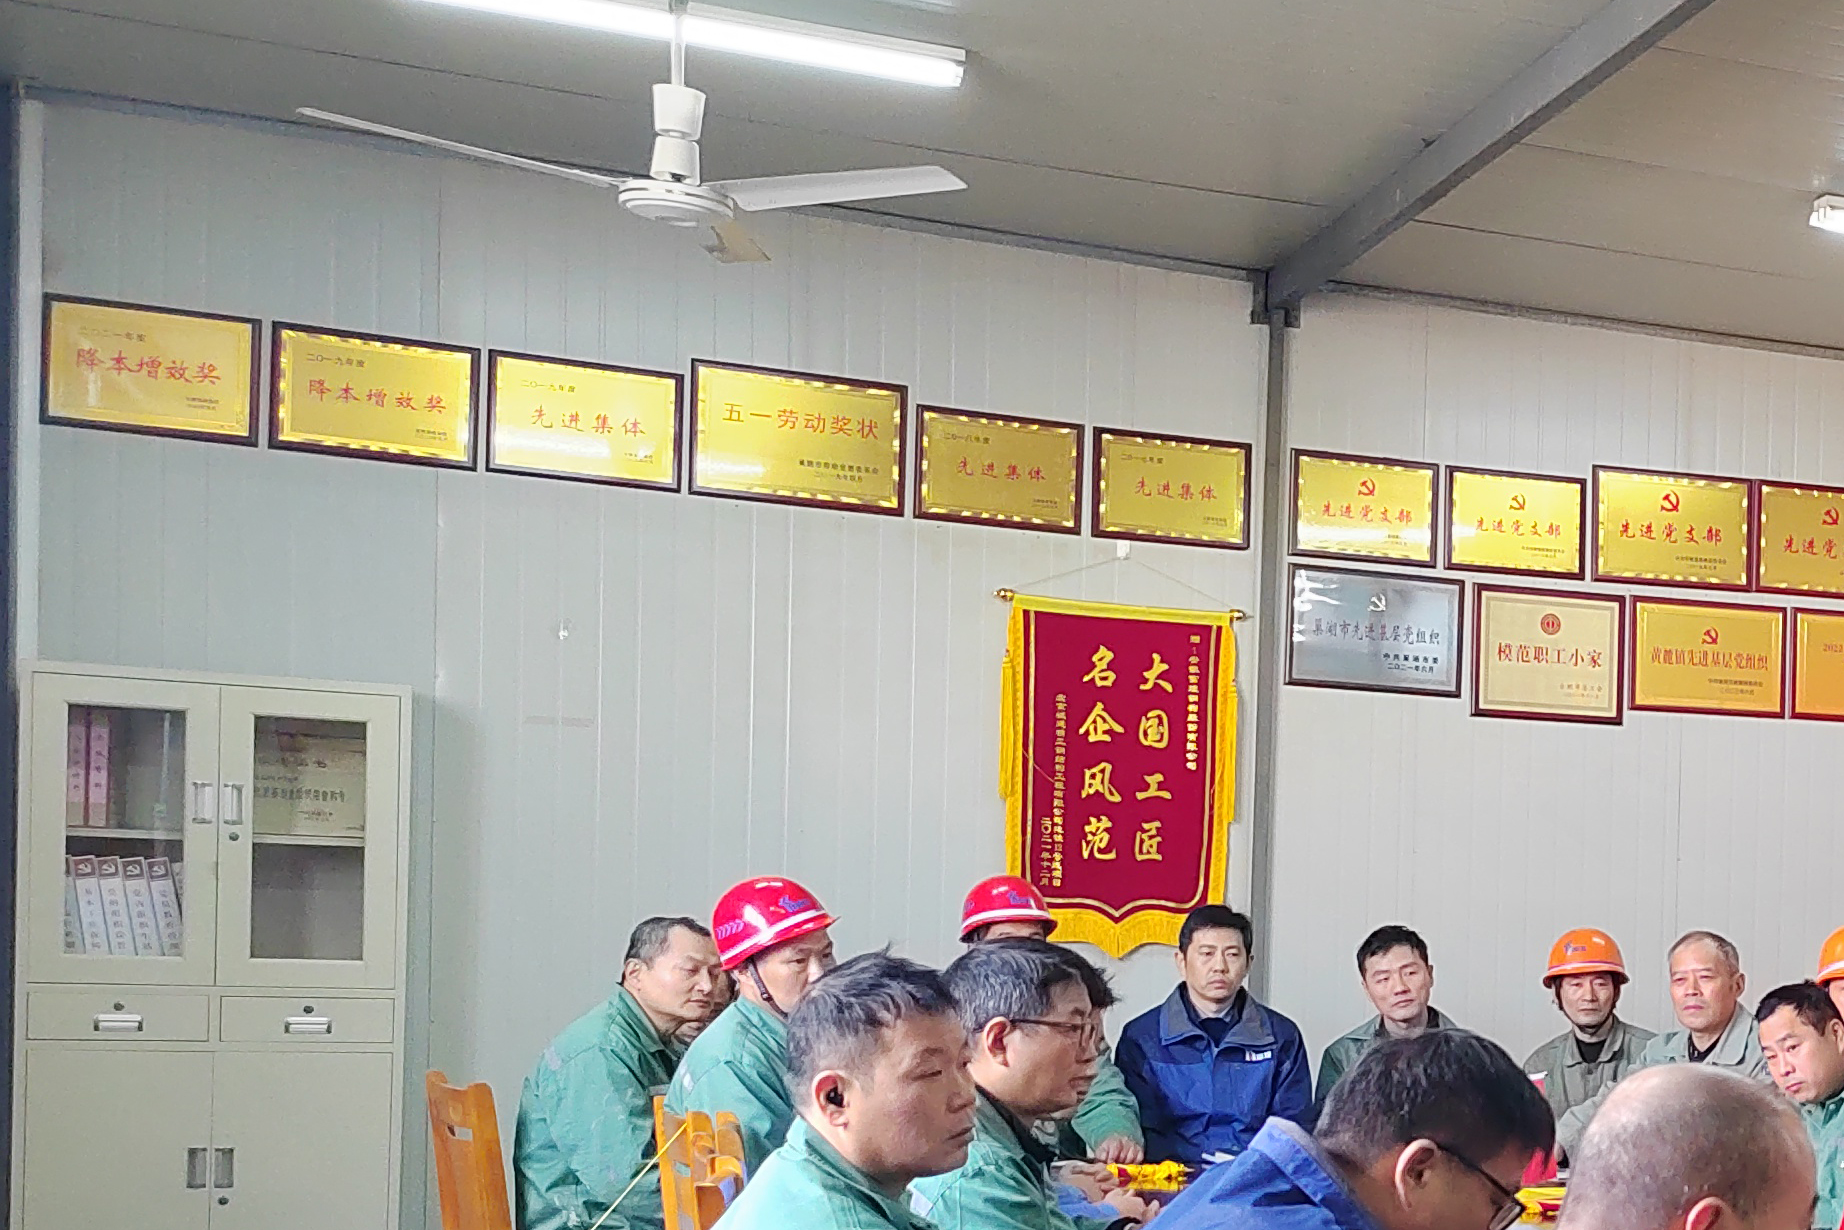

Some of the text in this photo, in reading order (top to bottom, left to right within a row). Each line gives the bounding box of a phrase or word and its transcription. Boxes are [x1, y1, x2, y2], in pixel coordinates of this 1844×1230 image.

[76, 347, 221, 386] 降本增效奖
[309, 379, 447, 415] 降本增效奖
[532, 404, 646, 437] 先进集体
[722, 402, 880, 441] 五一劳动奖状
[956, 455, 1047, 483] 先进集体
[1135, 476, 1218, 501] 先进集体
[1322, 500, 1413, 526] 先进党支部
[1475, 516, 1562, 538] 先进党支部
[1619, 519, 1723, 547] 先进党支部
[1497, 642, 1603, 669] 模范职工小家
[1651, 646, 1770, 673] 黄麓镇先进基层党组织
[1079, 645, 1125, 861] 名企风范
[1134, 653, 1173, 862] 大国工匠
